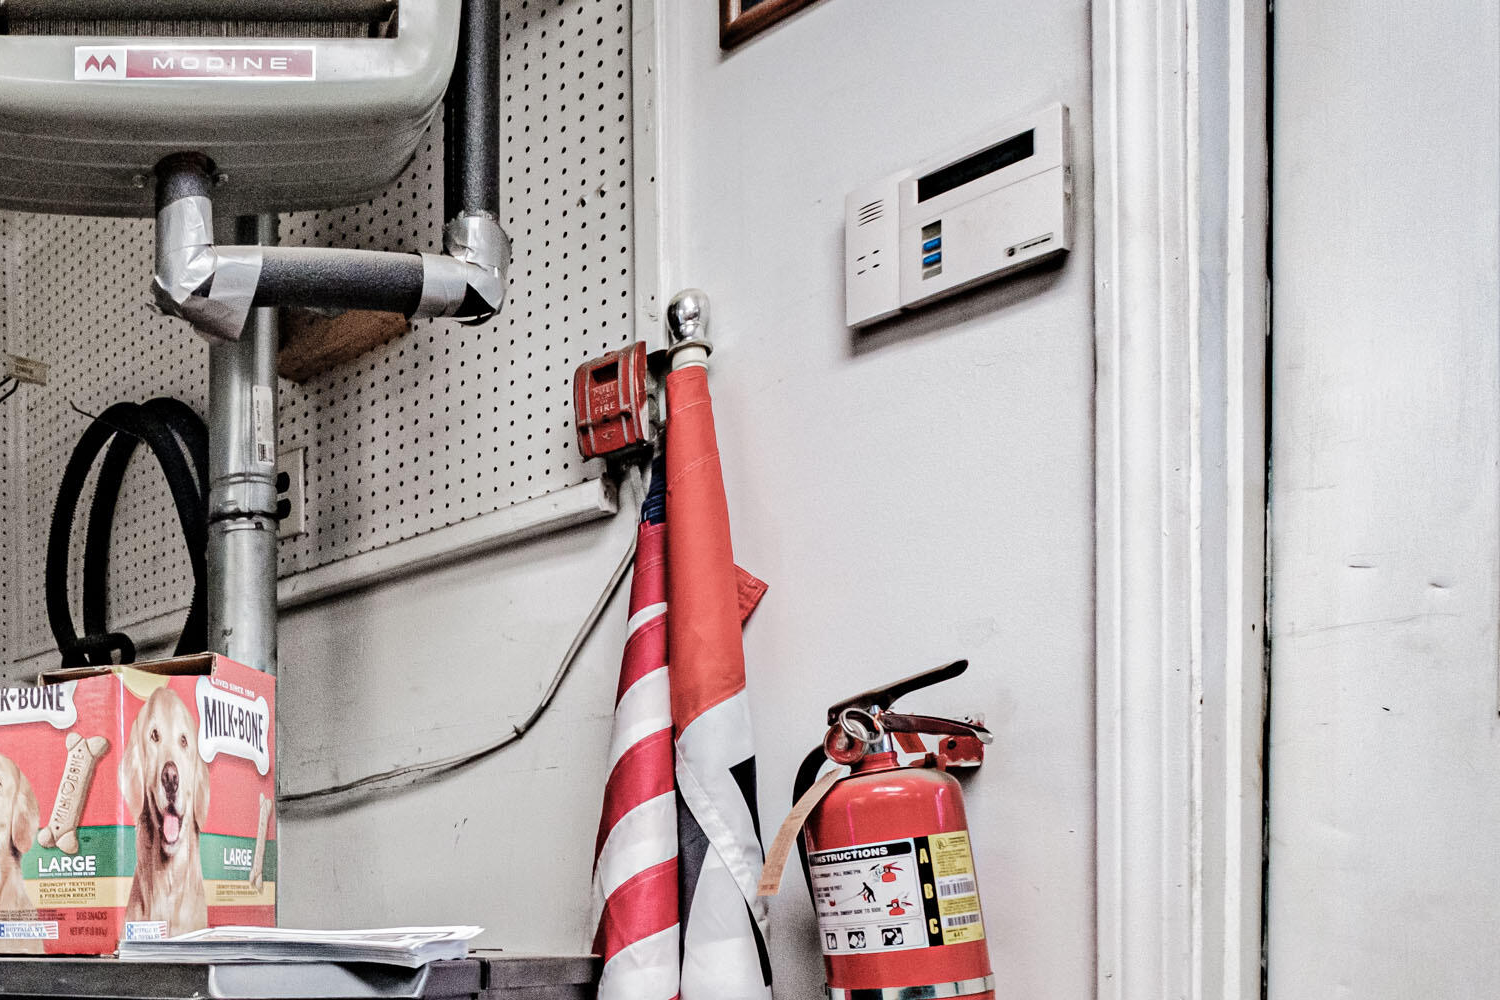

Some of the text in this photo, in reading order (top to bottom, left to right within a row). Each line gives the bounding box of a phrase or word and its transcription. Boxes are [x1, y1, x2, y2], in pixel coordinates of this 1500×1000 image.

[153, 56, 288, 70] MODINE
[594, 401, 616, 415] FIRE
[38, 855, 96, 873] LARGE
[223, 848, 253, 866] LARGE
[919, 848, 939, 934] A B C
[76, 911, 87, 920] DOG
[87, 911, 107, 920] SNACKS
